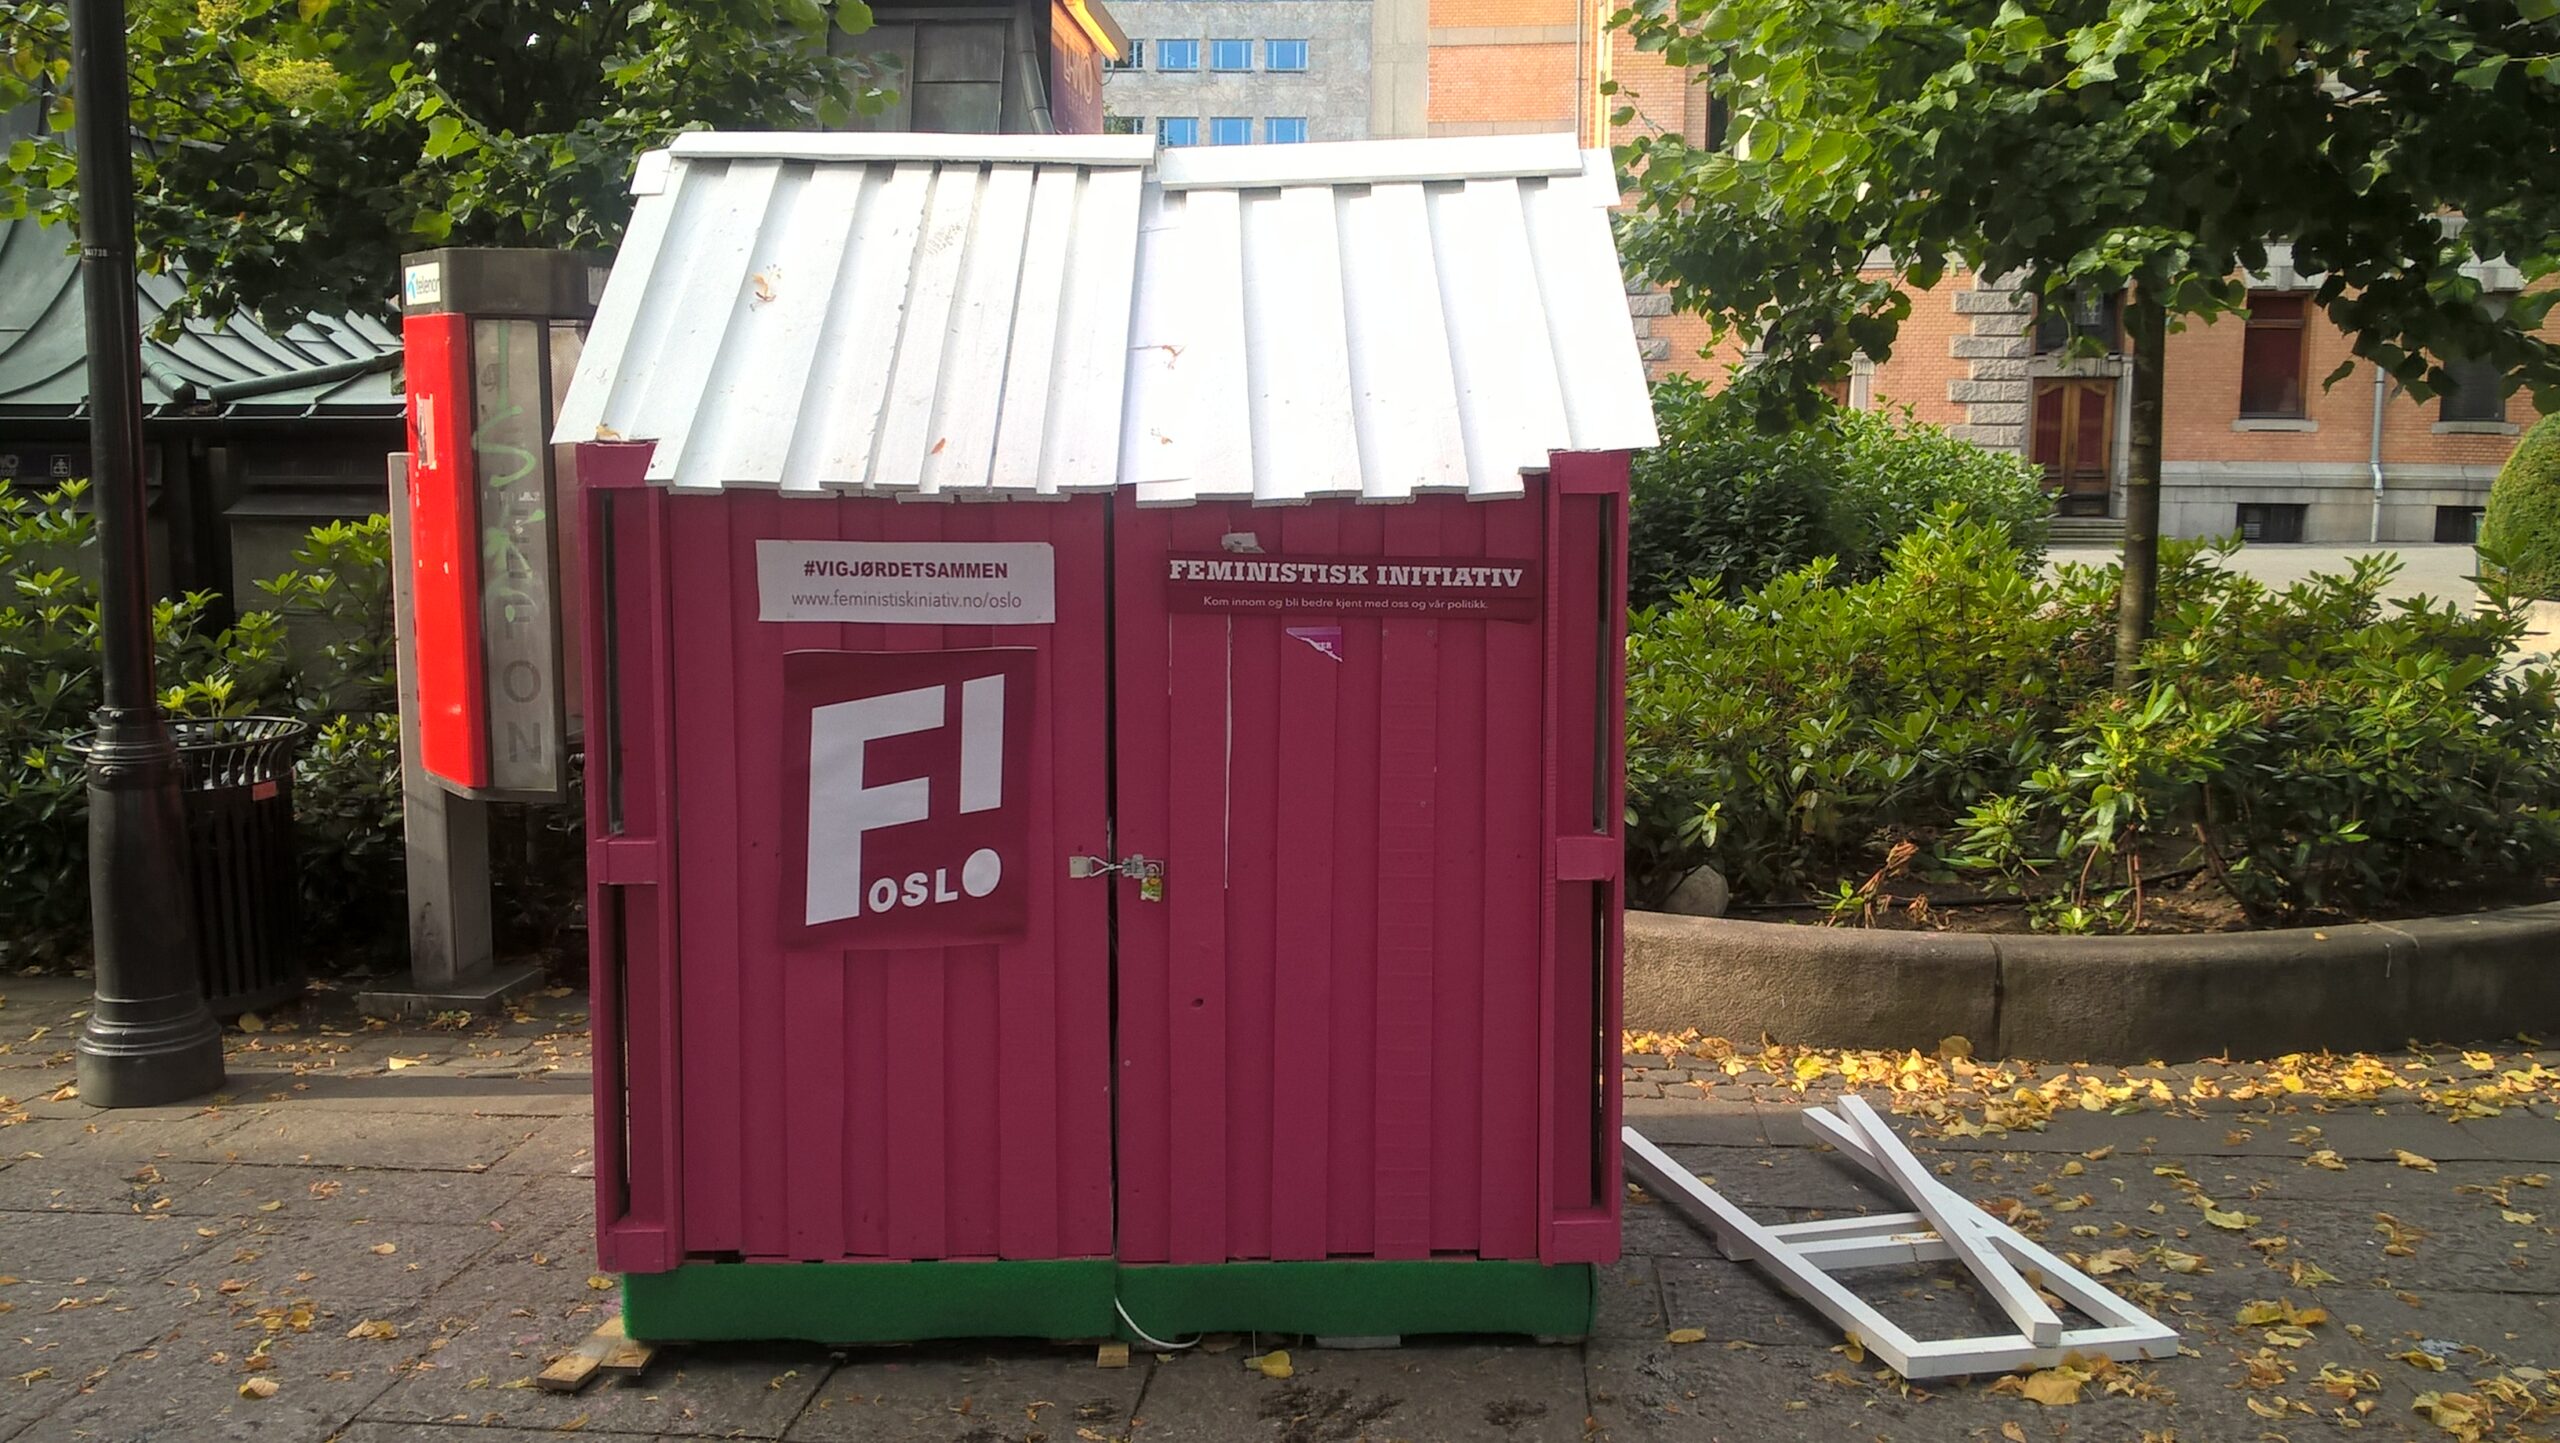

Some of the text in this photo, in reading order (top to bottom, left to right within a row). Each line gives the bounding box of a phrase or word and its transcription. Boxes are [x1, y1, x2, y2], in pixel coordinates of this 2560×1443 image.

[804, 560, 1008, 579] #VIGJØRDETSAMMEN
[1169, 560, 1523, 588] FEMINISTISK INITIATIV
[791, 589, 1022, 609] www.feministiskiniativ.no/oslo
[1203, 596, 1489, 612] Kom innom og bli bedre kjent med oss og vår politikk.
[805, 673, 1005, 926] F!
[867, 847, 1002, 913] OSLO
